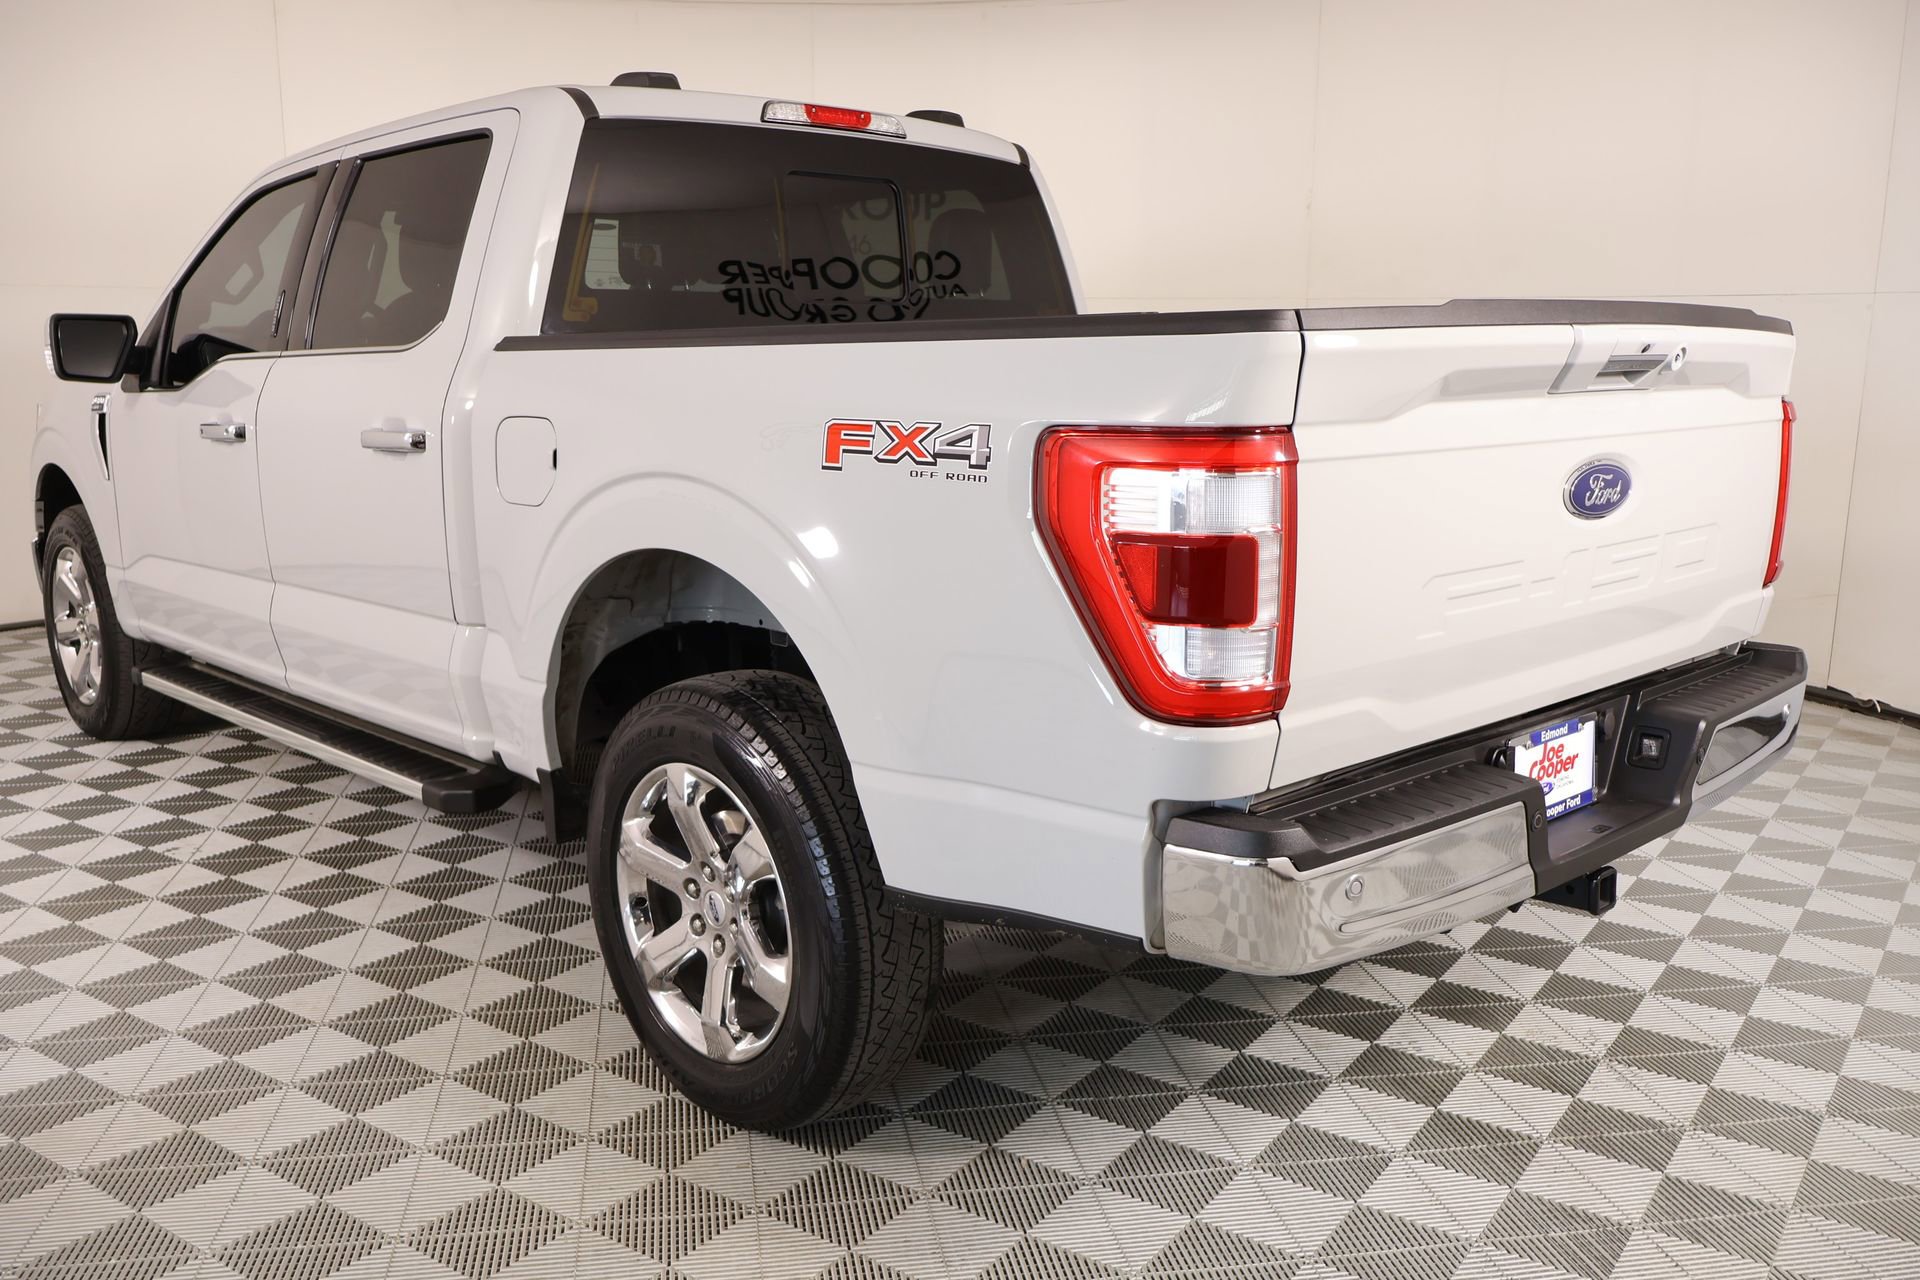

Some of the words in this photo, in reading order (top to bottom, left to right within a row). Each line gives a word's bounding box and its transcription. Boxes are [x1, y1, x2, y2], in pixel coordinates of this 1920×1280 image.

[821, 417, 992, 471] FX4
[909, 470, 939, 479] OFF
[945, 472, 988, 483] ROAD
[1584, 470, 1622, 507] Ford
[1541, 723, 1568, 741] Edmond
[613, 724, 676, 774] PIRELLI
[1539, 742, 1564, 765] Joe
[1529, 753, 1578, 781] Cooper
[1566, 795, 1581, 809] Ford
